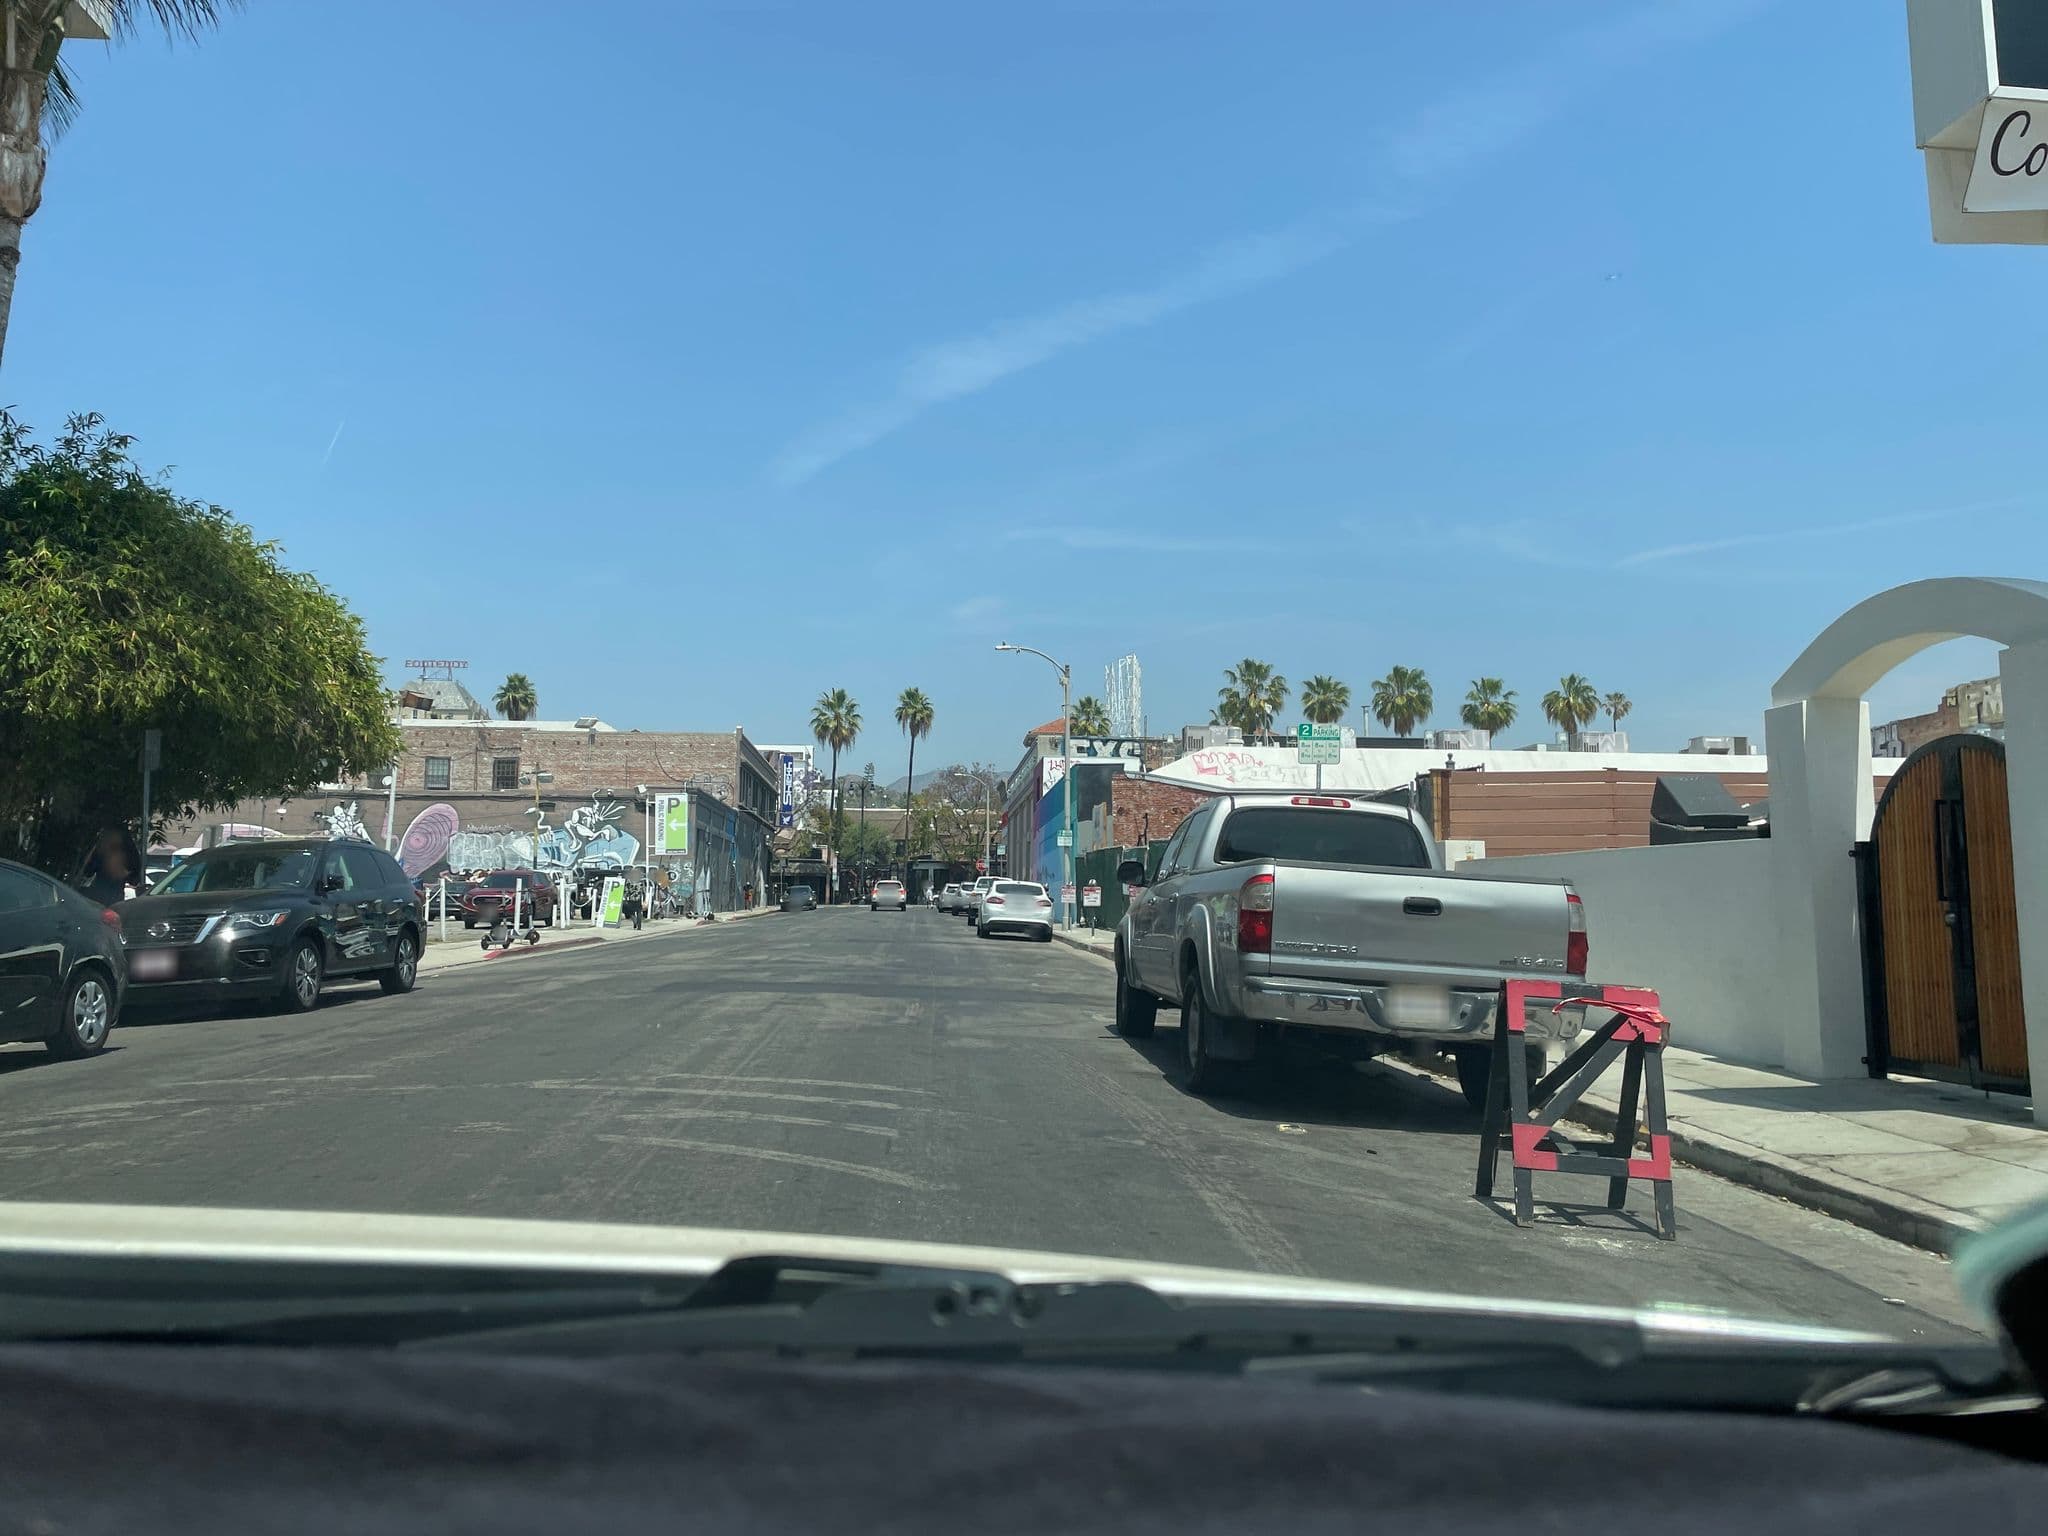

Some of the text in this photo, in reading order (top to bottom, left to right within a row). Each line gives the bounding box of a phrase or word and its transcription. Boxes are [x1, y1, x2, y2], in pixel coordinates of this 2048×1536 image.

[1302, 725, 1310, 736] 2
[668, 798, 681, 814] P
[611, 881, 621, 892] P
